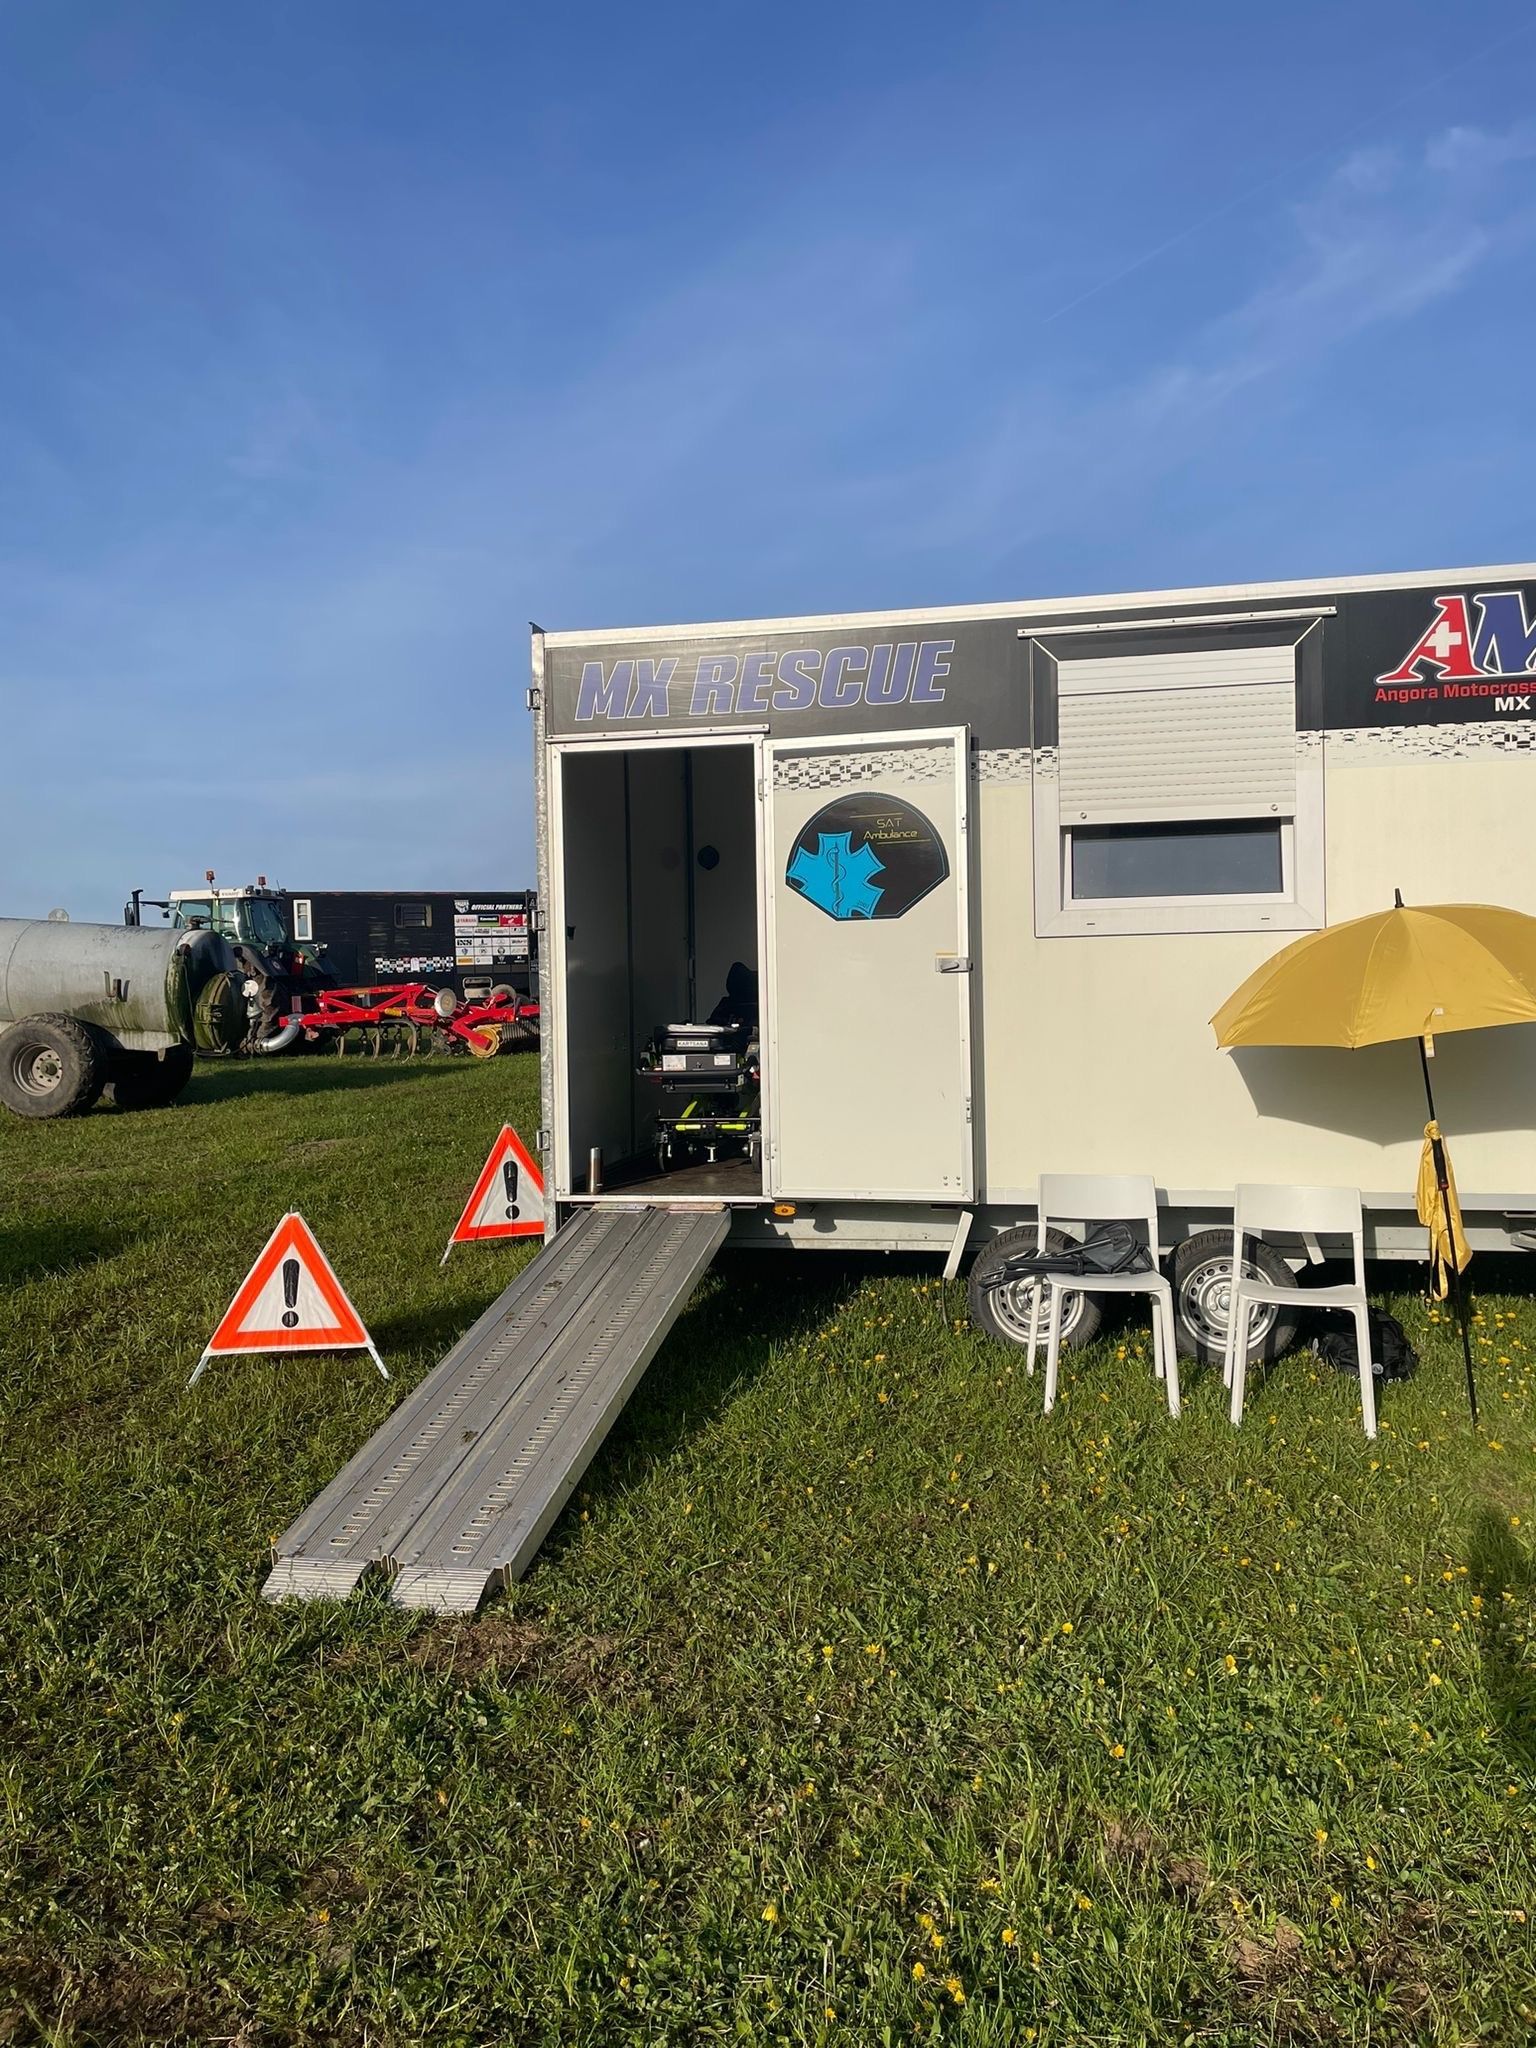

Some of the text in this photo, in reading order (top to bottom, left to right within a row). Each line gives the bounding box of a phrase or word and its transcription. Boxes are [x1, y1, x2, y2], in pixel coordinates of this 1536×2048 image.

[575, 639, 956, 721] MX RESCUE
[1375, 688, 1438, 703] Angora
[1494, 696, 1531, 712] MX
[876, 817, 902, 828] SAT
[863, 829, 918, 840] Ambulance
